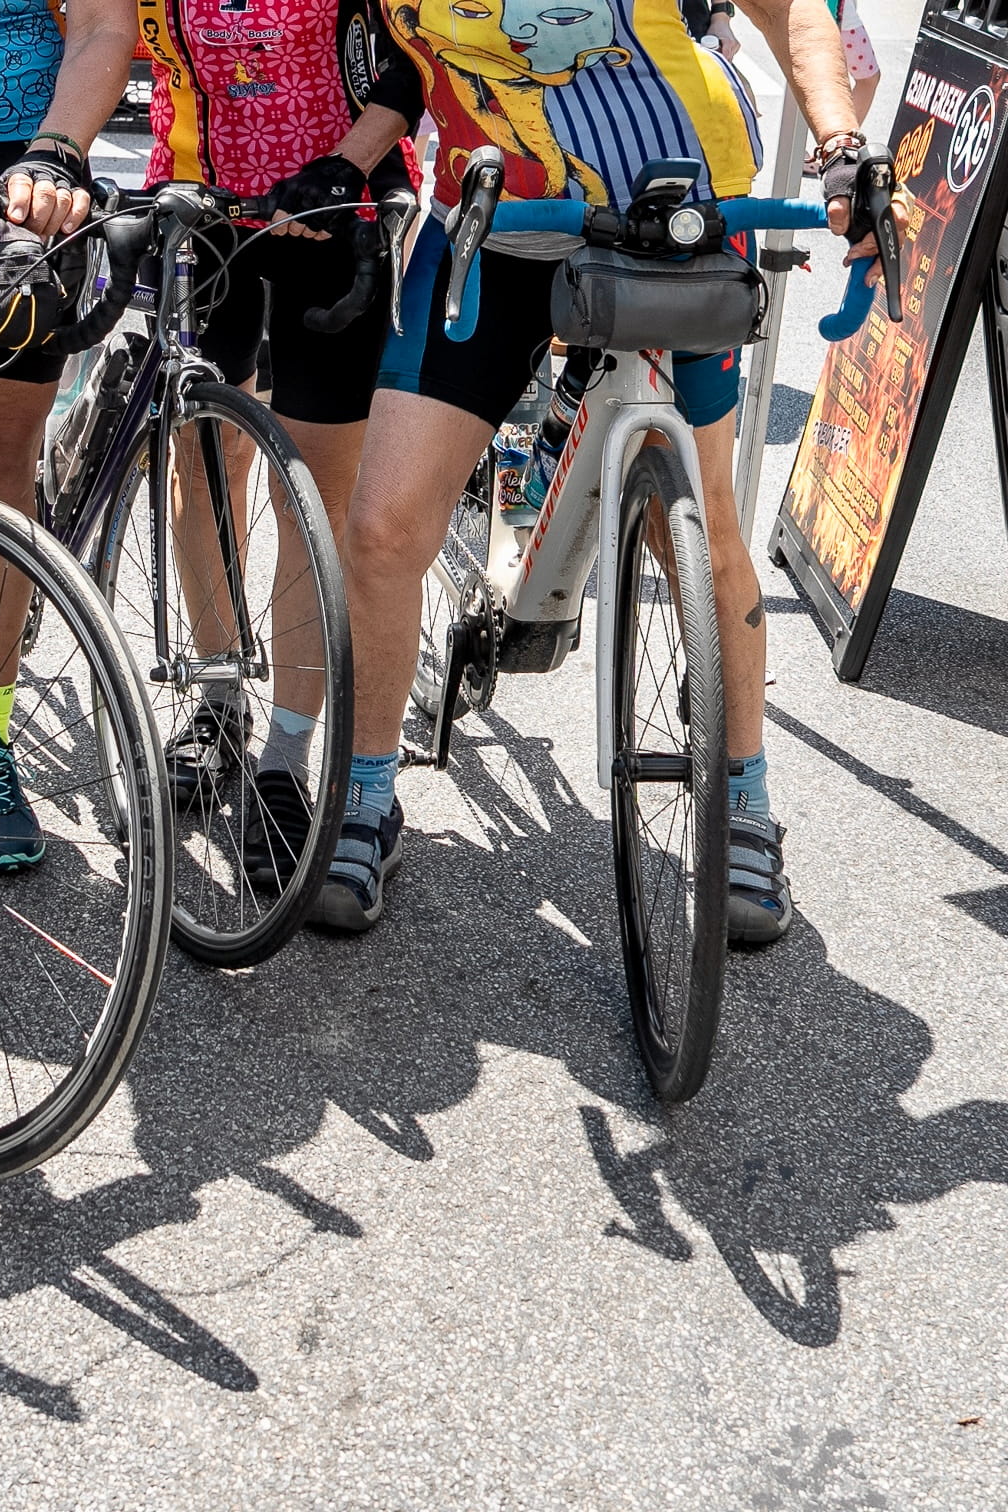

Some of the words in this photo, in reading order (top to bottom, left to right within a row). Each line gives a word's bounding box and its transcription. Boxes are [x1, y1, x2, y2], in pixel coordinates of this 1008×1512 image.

[143, 17, 182, 88] Cycling
[206, 29, 232, 40] Body
[248, 29, 283, 38] Basics
[352, 22, 370, 97] KESWIC
[350, 60, 363, 97] CYCLE
[904, 69, 938, 113] CEDAR
[930, 78, 968, 127] CREEK
[894, 116, 936, 184] BBQ
[461, 219, 479, 259] GRX
[884, 219, 896, 260] GRX
[150, 508, 159, 602] REYNOLDS
[134, 741, 154, 906] SERFAS
